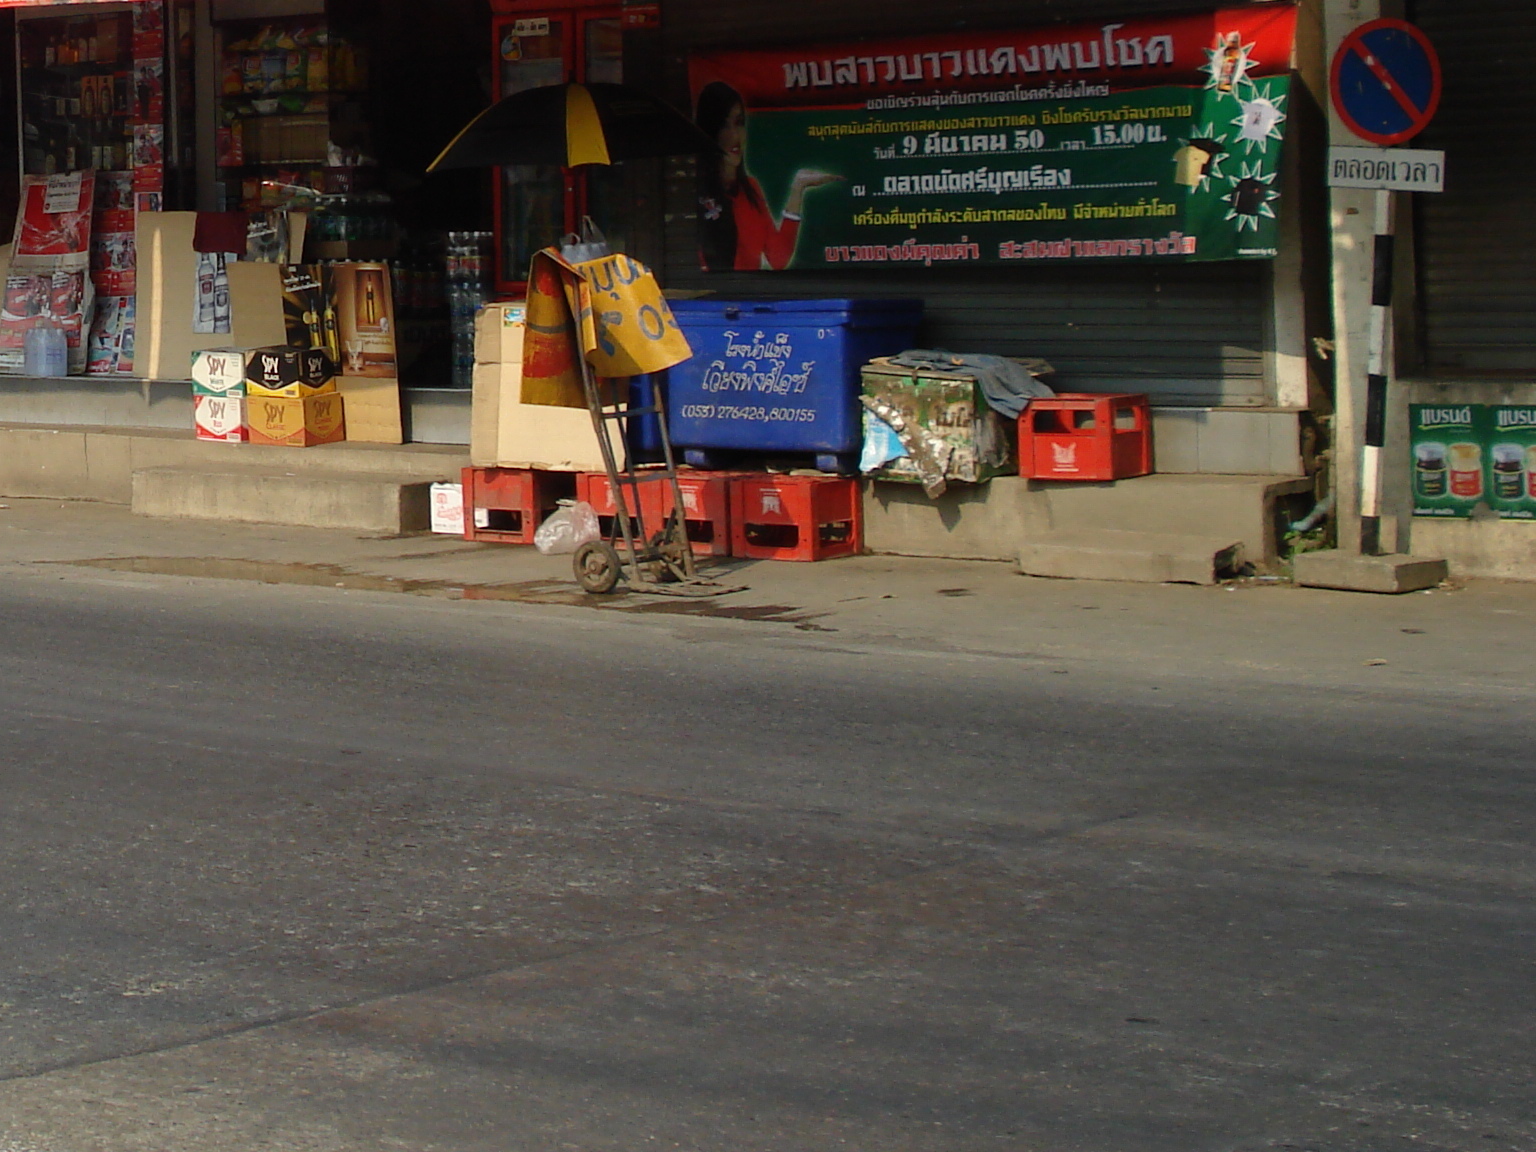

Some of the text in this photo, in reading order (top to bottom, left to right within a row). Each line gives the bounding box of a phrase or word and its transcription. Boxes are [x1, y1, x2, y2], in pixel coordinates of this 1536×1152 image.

[783, 23, 1175, 90] พบสาวบาวแดงพบโชค
[902, 136, 918, 155] 9
[923, 131, 1007, 154] มีนาคม
[1014, 128, 1044, 150] 50
[1092, 124, 1145, 147] 15.00
[1332, 156, 1440, 185] ตลอดเวลา
[206, 355, 227, 376] SPY
[261, 354, 280, 374] SPY
[264, 402, 285, 424] SPY
[681, 405, 715, 419] (053)
[1421, 406, 1471, 425] แบรนด์
